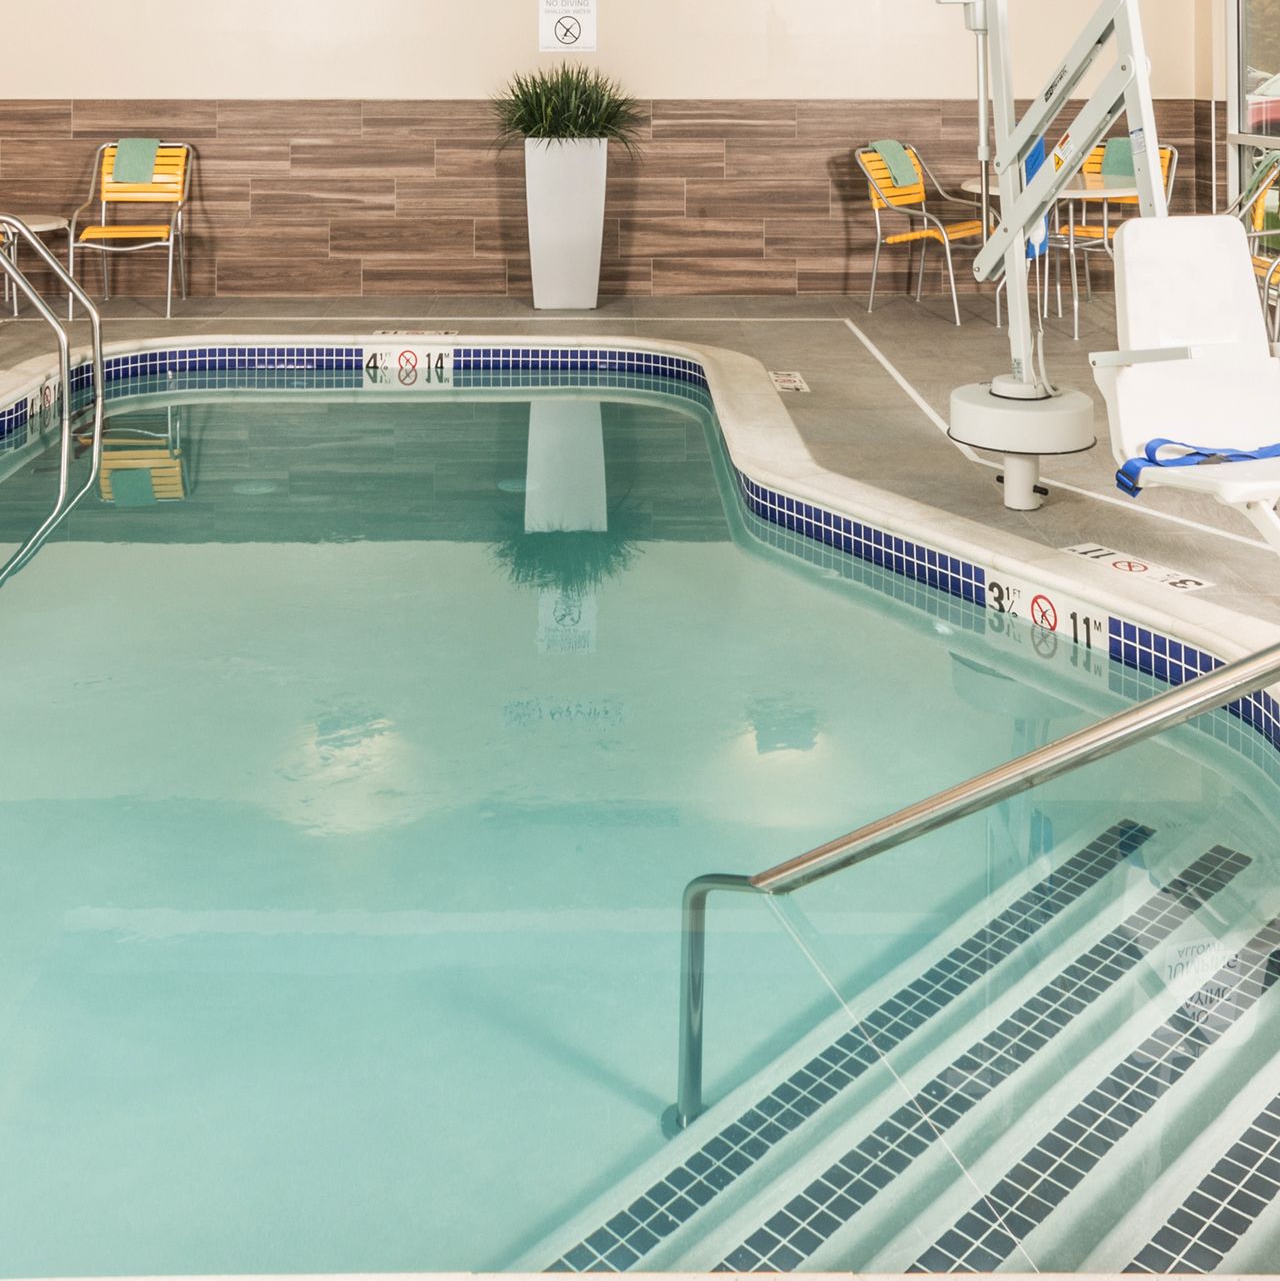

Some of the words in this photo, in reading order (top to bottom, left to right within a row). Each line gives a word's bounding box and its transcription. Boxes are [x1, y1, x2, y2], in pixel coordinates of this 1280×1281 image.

[545, 0, 559, 7] NO
[560, 0, 590, 7] DIVING
[1093, 619, 1102, 633] M
